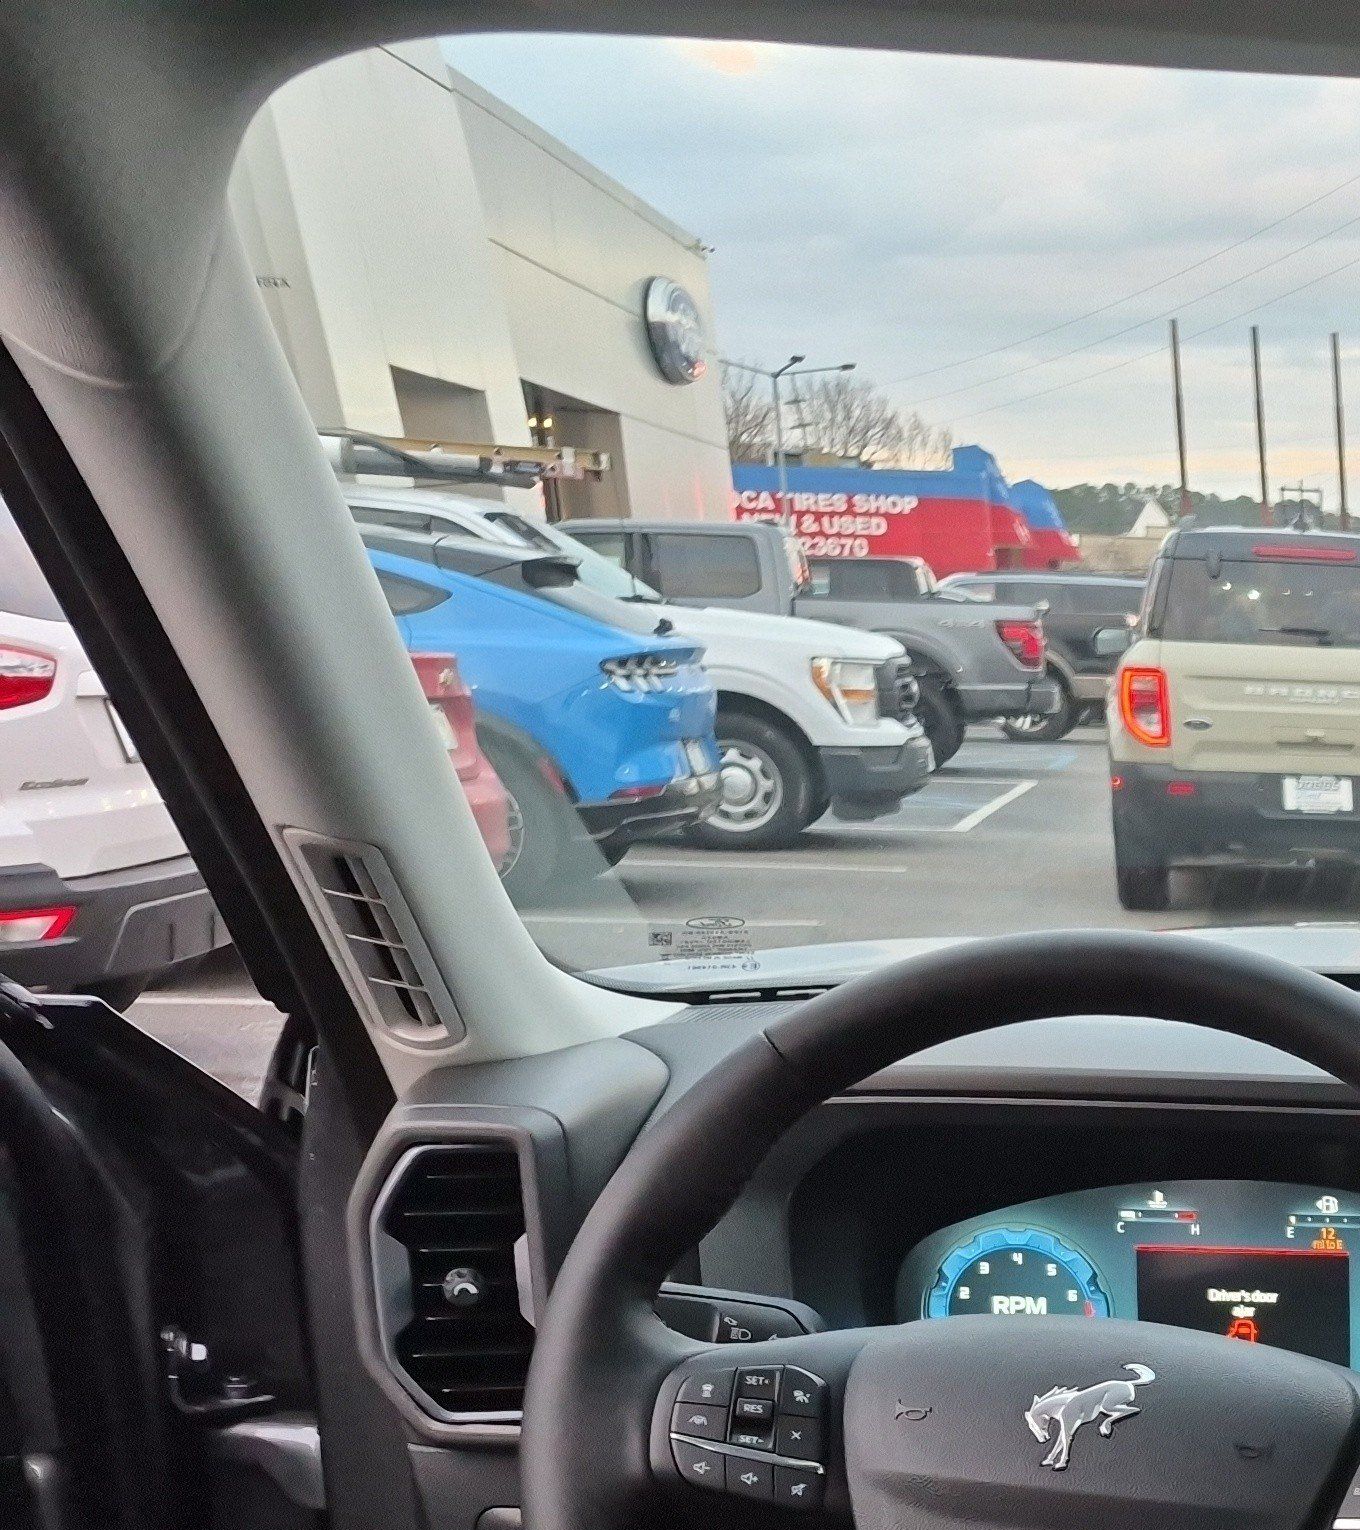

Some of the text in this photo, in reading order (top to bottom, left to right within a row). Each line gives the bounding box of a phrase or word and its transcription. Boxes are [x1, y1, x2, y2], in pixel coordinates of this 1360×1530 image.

[852, 493, 918, 515] SHOP
[800, 514, 820, 534] &
[821, 514, 888, 536] USED
[1116, 1222, 1125, 1233] C
[1191, 1225, 1200, 1235] H
[1286, 1227, 1295, 1239] E
[1321, 1228, 1335, 1239] 12
[1013, 1253, 1023, 1264] 4
[979, 1262, 990, 1274] 3
[1047, 1264, 1057, 1276] 5
[960, 1287, 970, 1299] 2
[1068, 1290, 1078, 1302] 6
[1207, 1288, 1278, 1302] Driver's door
[991, 1295, 1047, 1315] RPM
[743, 1403, 763, 1414] RES
